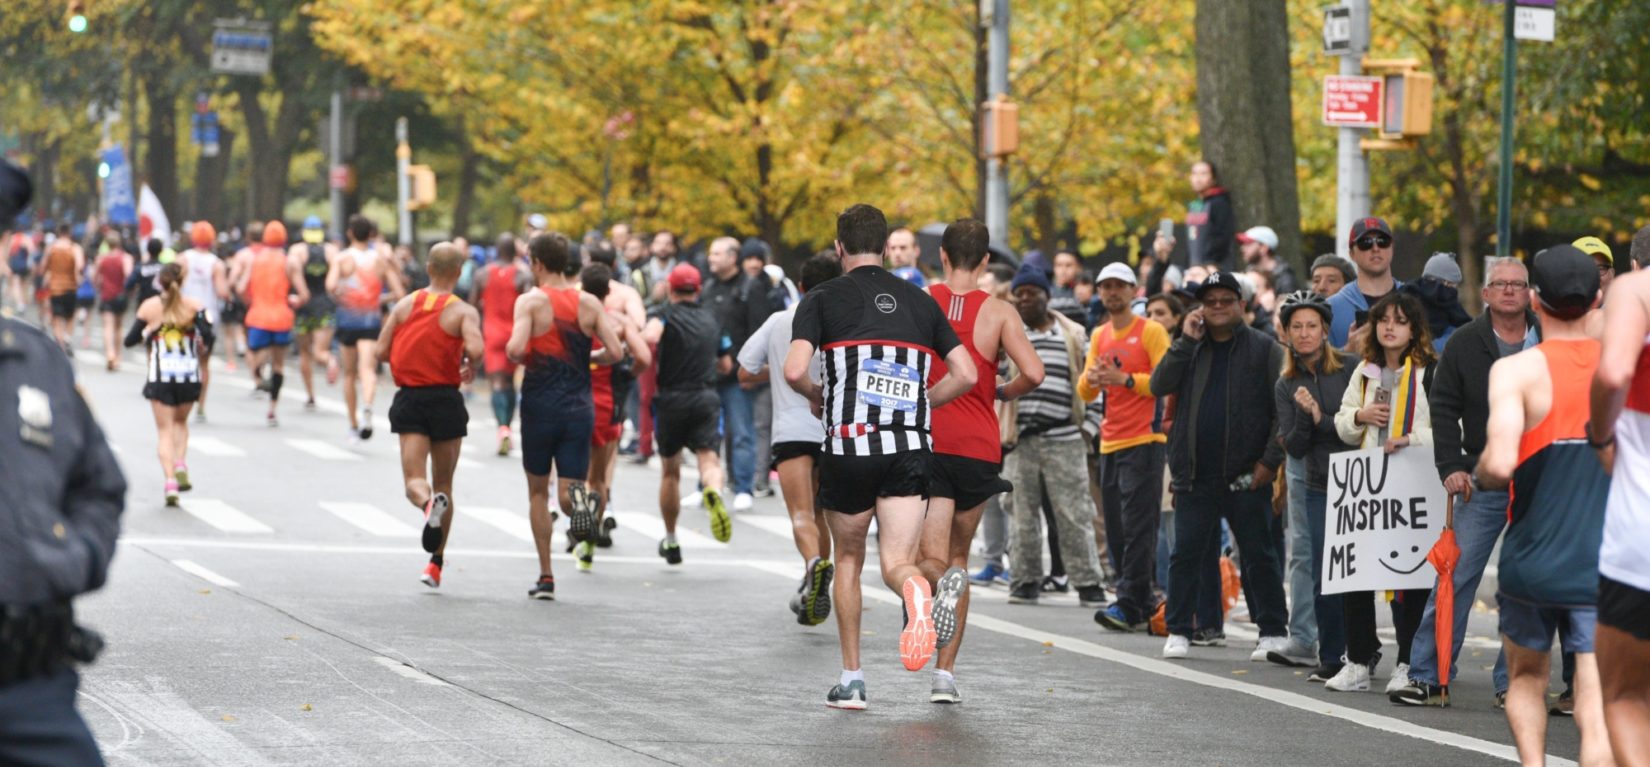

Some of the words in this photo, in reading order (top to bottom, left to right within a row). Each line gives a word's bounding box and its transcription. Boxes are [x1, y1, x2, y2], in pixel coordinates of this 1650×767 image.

[866, 375, 911, 398] PETER
[881, 398, 898, 407] 2017
[1332, 453, 1389, 509] YOU
[1336, 497, 1428, 535] INSPIRE
[1328, 542, 1356, 581] ME
